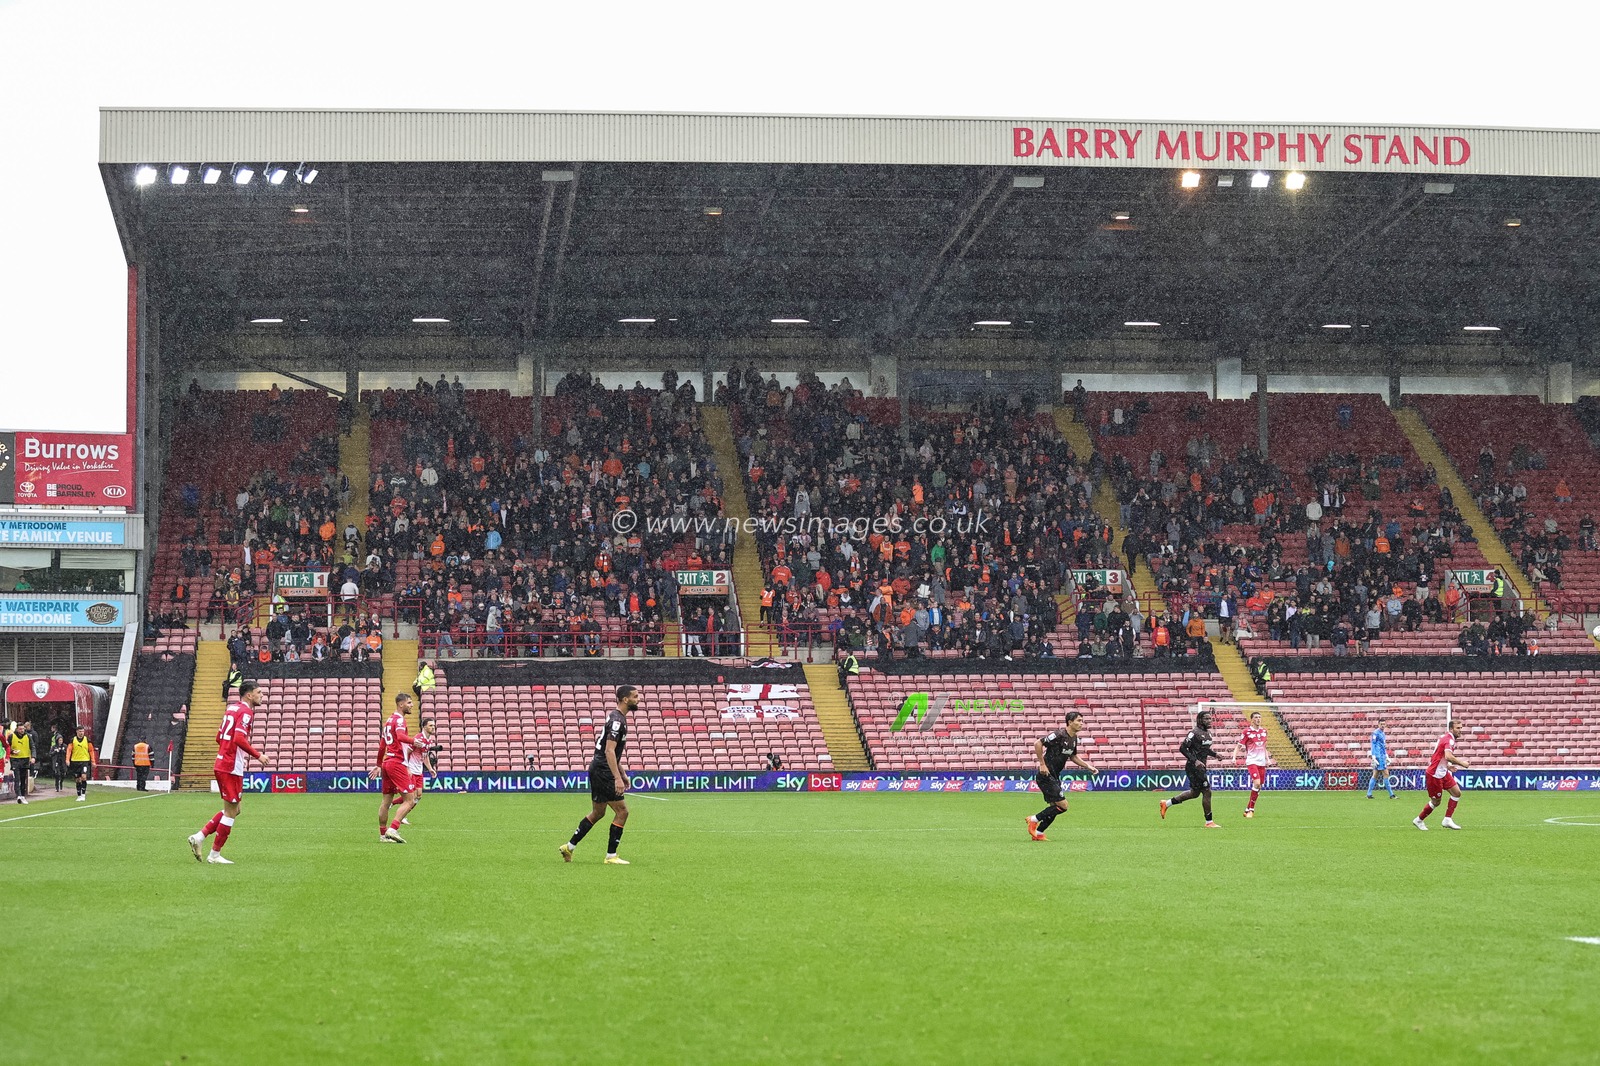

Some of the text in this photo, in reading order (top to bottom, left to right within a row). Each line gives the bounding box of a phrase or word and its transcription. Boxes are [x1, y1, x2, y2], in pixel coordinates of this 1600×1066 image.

[1012, 127, 1471, 166] BARRY MURPHY STAND
[25, 438, 119, 460] Burrows
[25, 461, 114, 473] Driving Value in Yorkshire
[9, 521, 67, 530] METRODOME
[13, 530, 63, 542] FAMILY
[66, 531, 113, 543] VENUE
[278, 574, 325, 587] EXIT 1
[677, 572, 726, 585] EXIT 2
[1072, 572, 1119, 584] EXI 3
[6, 601, 80, 612] WATERPARK
[1, 613, 72, 624] ETRODOME
[242, 774, 270, 793] sky
[275, 775, 304, 789] bet
[328, 776, 369, 790] JOIN
[423, 776, 473, 790] EARLY
[487, 776, 557, 790] MILLION
[561, 776, 590, 790] WH
[663, 776, 710, 790] THEIR
[714, 776, 757, 790] LIMIT
[776, 773, 839, 791] sky bet
[846, 780, 876, 790] sky bet
[888, 780, 918, 790] sky bet
[930, 781, 961, 791] sky bet
[973, 781, 1003, 791] sky bet
[1015, 781, 1029, 791] sky
[1071, 781, 1086, 790] bet
[1091, 774, 1131, 788] WHO
[1136, 774, 1187, 788] KNOW
[1207, 774, 1235, 788] EIR
[1239, 774, 1280, 788] LIIT
[1295, 772, 1355, 790] sky bet
[1454, 775, 1512, 789] NEARLY
[1541, 780, 1559, 790] sky
[1559, 780, 1577, 788] bet
